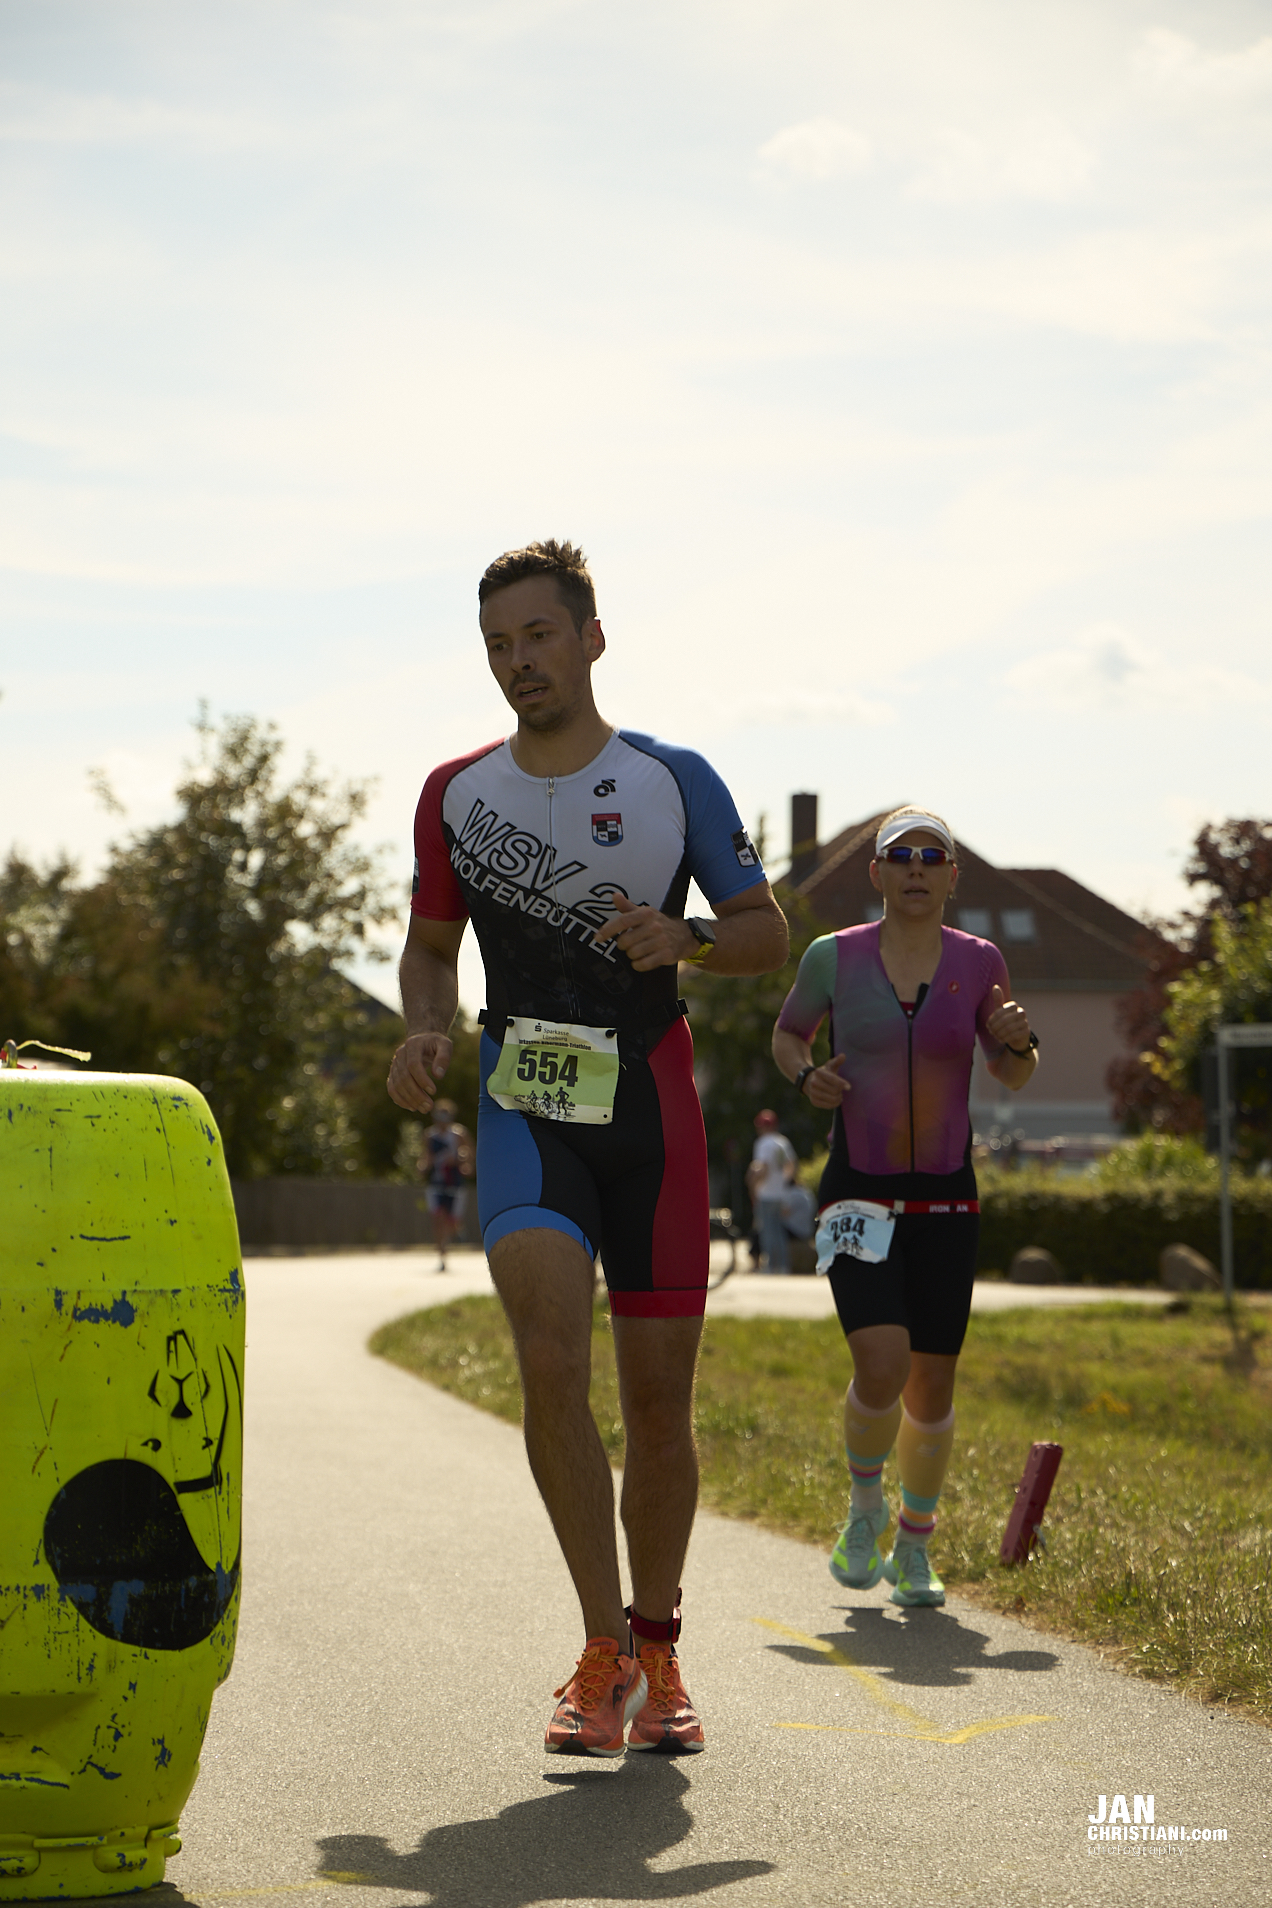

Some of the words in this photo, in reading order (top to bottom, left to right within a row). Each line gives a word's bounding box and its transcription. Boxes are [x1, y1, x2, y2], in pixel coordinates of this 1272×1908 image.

[459, 798, 588, 895] WSV
[450, 843, 617, 963] WOLFENBÜTTEL
[543, 1028, 569, 1036] Sparkasse
[517, 1049, 578, 1087] 554
[830, 1217, 865, 1243] 284
